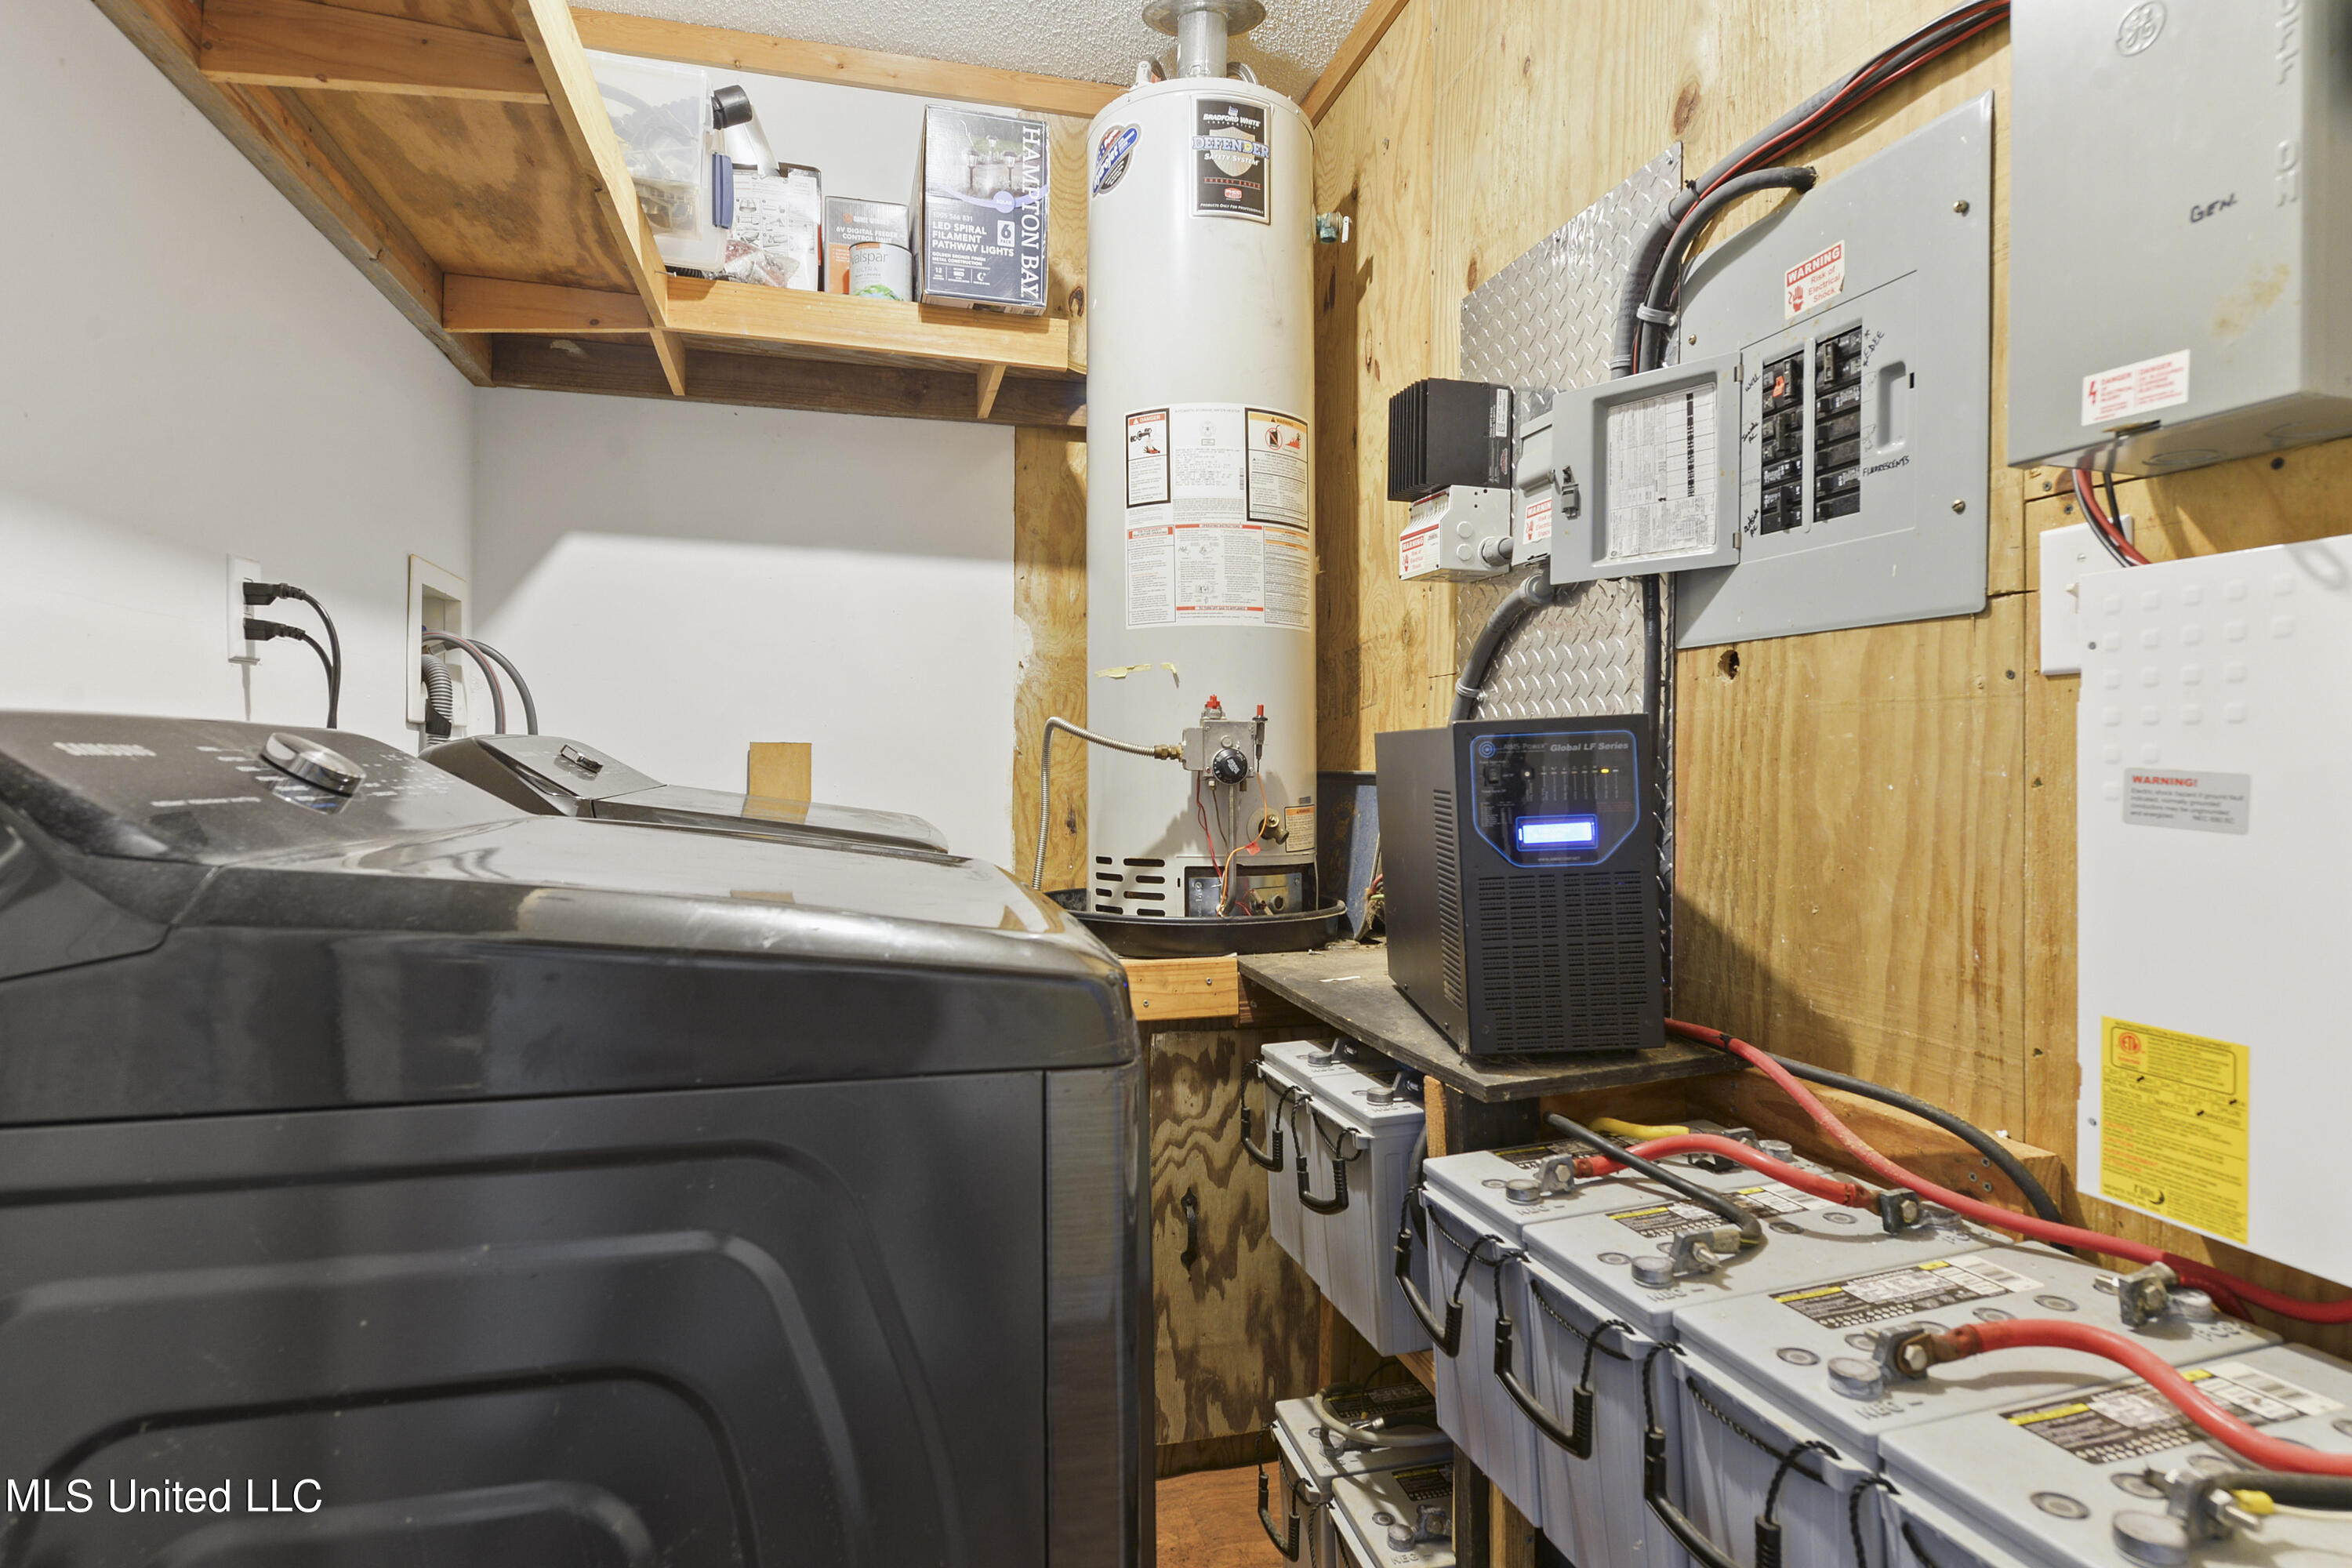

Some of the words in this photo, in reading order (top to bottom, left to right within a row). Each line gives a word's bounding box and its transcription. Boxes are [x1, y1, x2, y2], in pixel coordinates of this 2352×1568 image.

[1203, 113, 1239, 122] BRADFORD
[1240, 117, 1261, 127] WHITE
[1192, 136, 1269, 158] DEFENDER
[1232, 154, 1260, 165] SYSTEM
[1022, 125, 1041, 249] HAMPTON
[2190, 194, 2238, 224] GEN
[847, 227, 873, 235] DIGITAL
[933, 221, 951, 230] LED
[954, 223, 987, 235] SPIRAL
[1000, 223, 1011, 239] 6
[932, 230, 982, 244] FILAMENT
[932, 239, 978, 252] PATHWAY
[981, 245, 1014, 257] LIGHTS
[948, 258, 982, 267] CONSTRUCTION
[1788, 247, 1840, 284] WARNING
[1020, 255, 1040, 299] BAY
[1811, 273, 1826, 284] Risk
[1828, 265, 1836, 275] of
[1808, 273, 1840, 296] Electrical
[1813, 287, 1835, 303] Shock
[1140, 415, 1160, 423] DANGER
[1528, 501, 1552, 517] WARNIN
[1551, 743, 1581, 752] Global
[1598, 742, 1628, 750] Series
[2132, 775, 2198, 787] WARNING!
[1516, 1204, 1550, 1216] NEG
[1647, 1287, 1688, 1301] NEG
[1854, 1399, 1904, 1421] NEG
[1392, 1553, 1419, 1565] NEG
